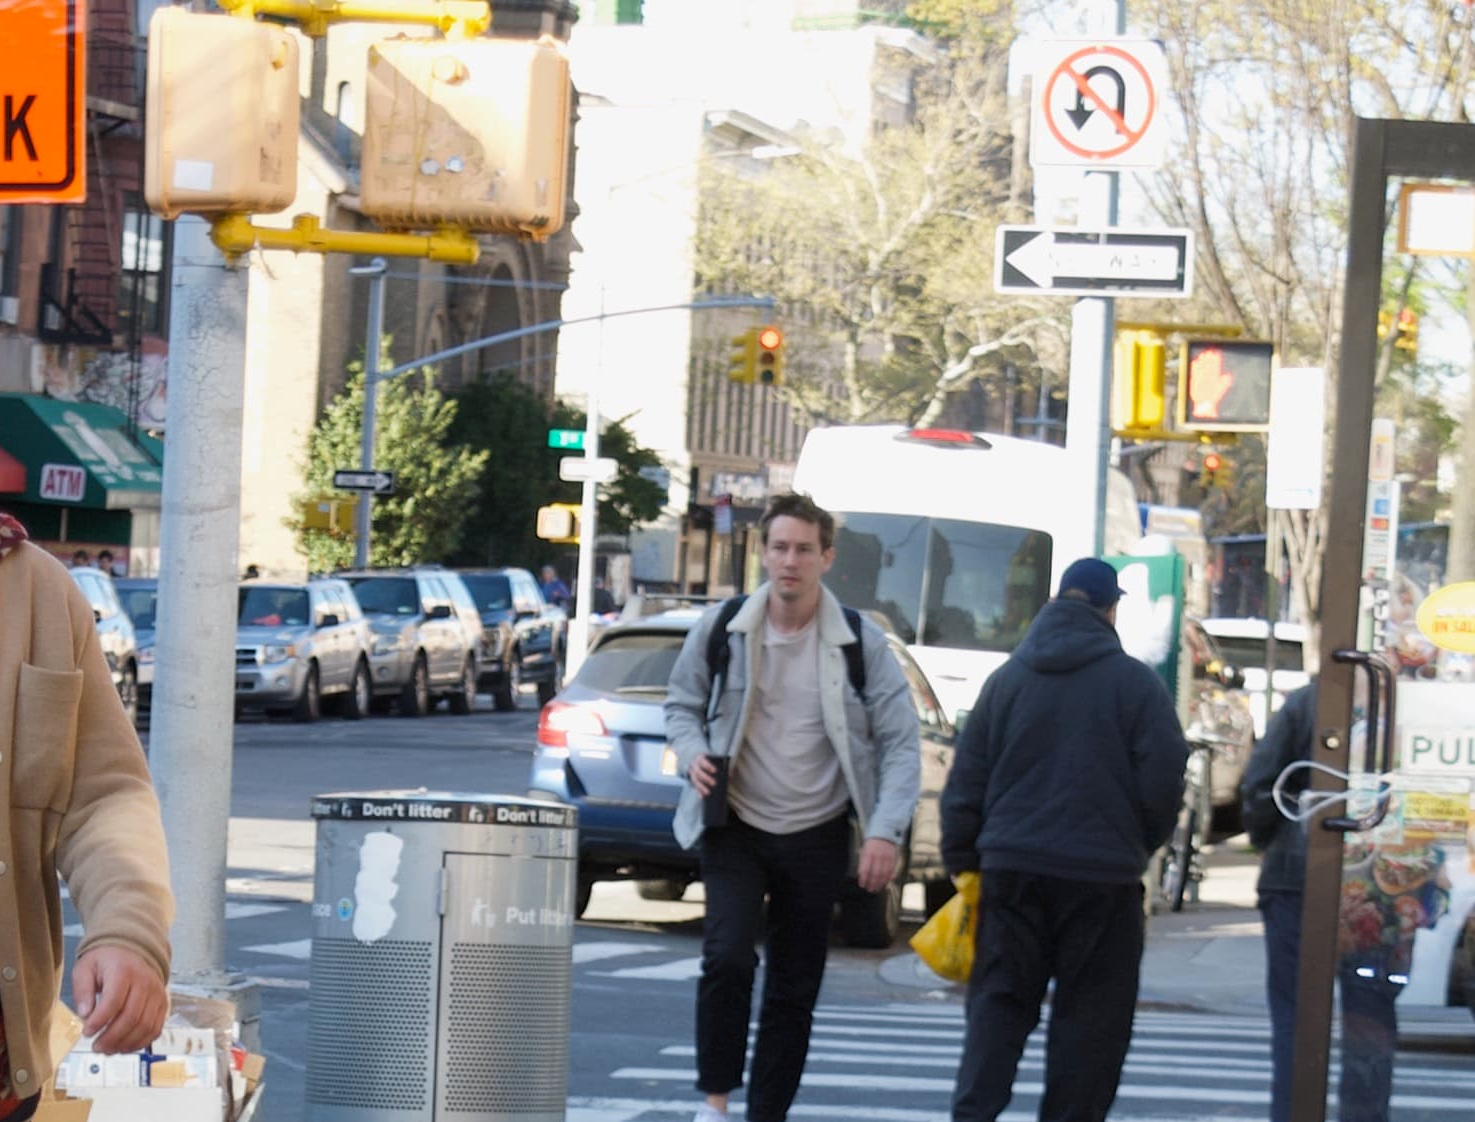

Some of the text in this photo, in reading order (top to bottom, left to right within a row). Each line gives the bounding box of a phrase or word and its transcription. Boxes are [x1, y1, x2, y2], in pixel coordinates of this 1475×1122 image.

[44, 469, 82, 497] ATM
[362, 802, 452, 819] Don't litter
[497, 807, 537, 824] Don't
[506, 906, 535, 925] Put
